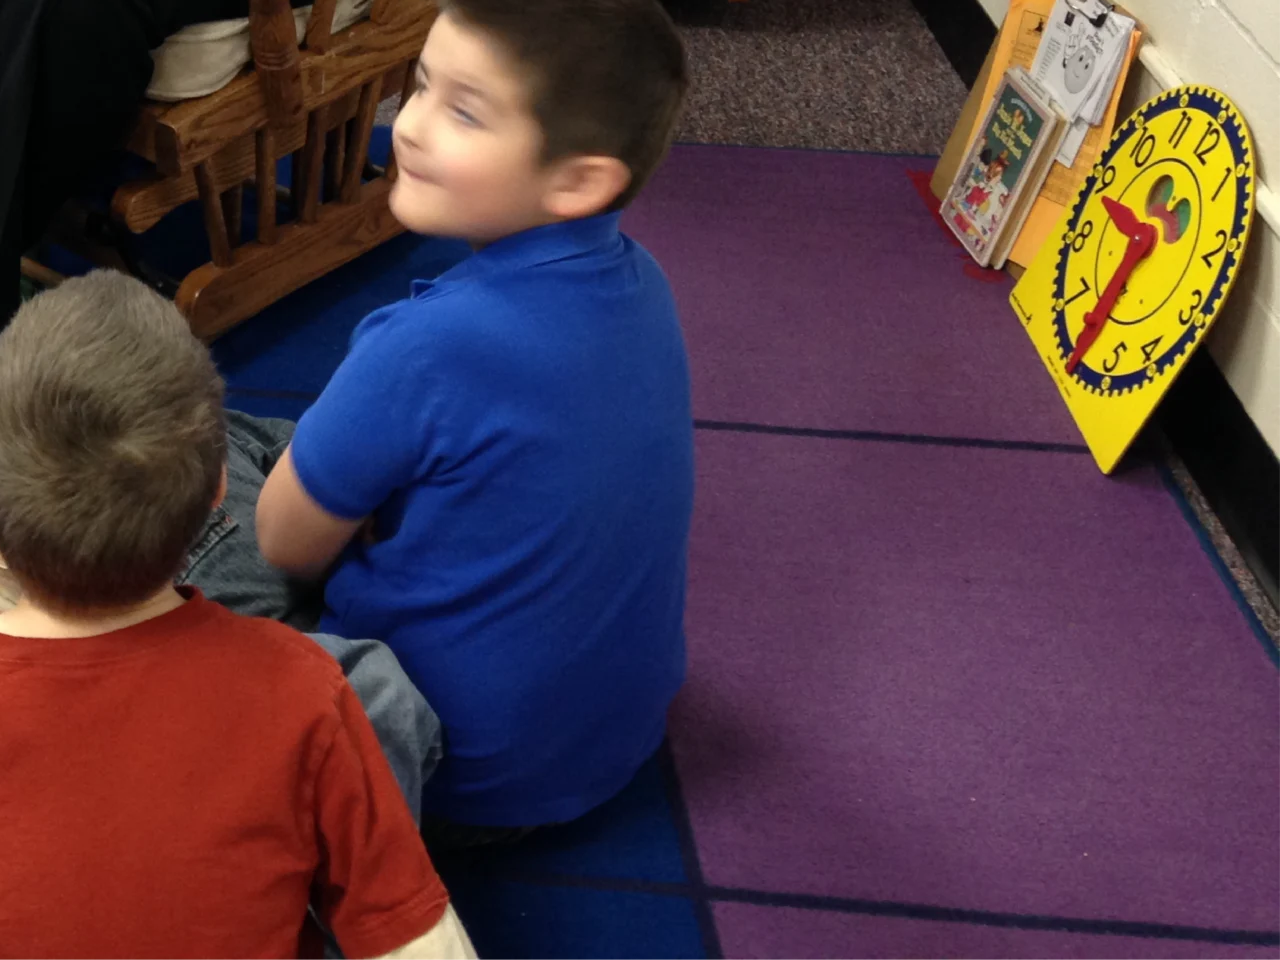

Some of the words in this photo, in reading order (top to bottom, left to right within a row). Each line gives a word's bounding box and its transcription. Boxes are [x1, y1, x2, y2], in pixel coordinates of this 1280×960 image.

[1129, 126, 1156, 168] 10
[1169, 111, 1192, 149] 11
[1193, 120, 1221, 166] 12
[1095, 165, 1116, 194] 9
[1211, 167, 1232, 202] 1
[1072, 220, 1093, 253] 8
[1201, 229, 1227, 269] 2
[1064, 276, 1090, 305] 7
[1179, 289, 1202, 326] 3
[1103, 341, 1128, 373] 5
[1141, 335, 1164, 364] 4
